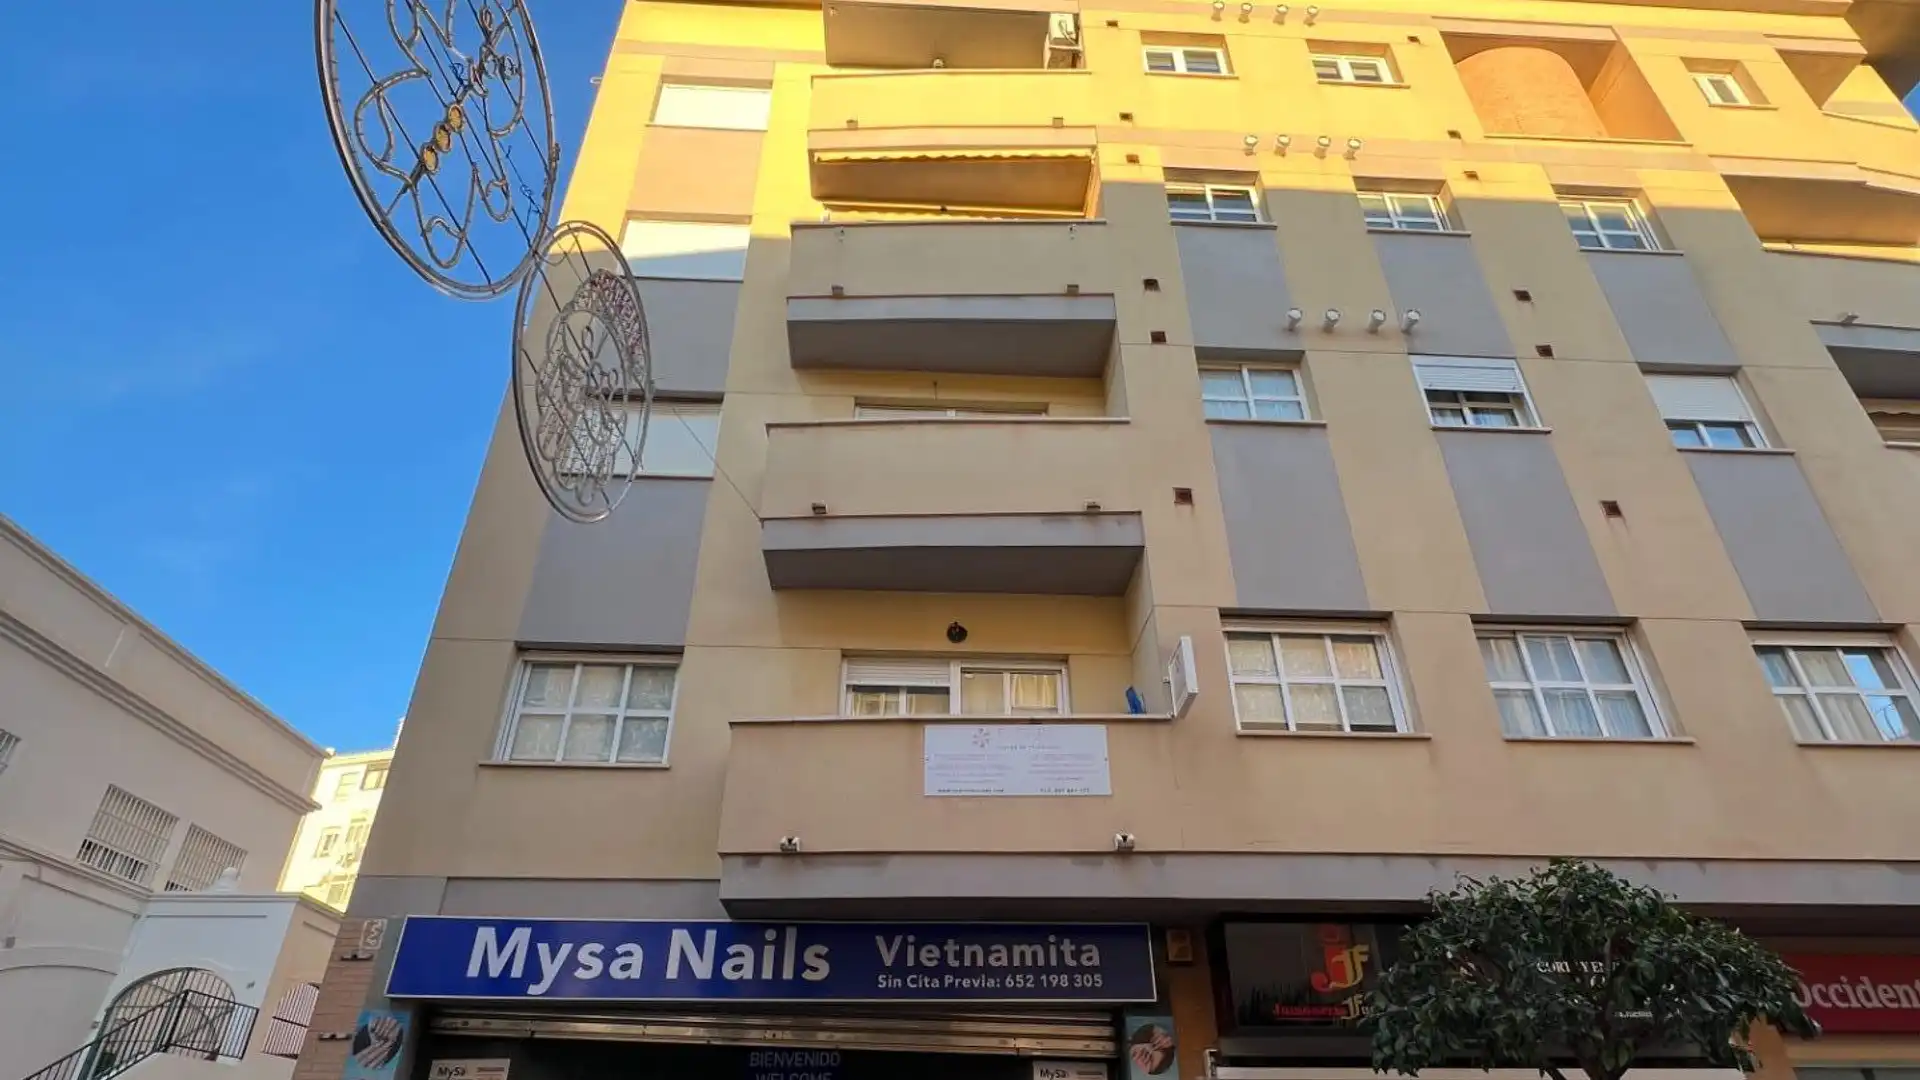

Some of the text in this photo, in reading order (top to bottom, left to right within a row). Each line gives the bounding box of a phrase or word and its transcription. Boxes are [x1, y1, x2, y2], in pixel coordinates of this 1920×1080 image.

[466, 926, 831, 995] Mysa Nails
[875, 934, 1101, 967] Vietnamita
[877, 974, 1103, 989] Sin Cita Previa: 652 198 305
[749, 1051, 841, 1068] BIENVENIDO
